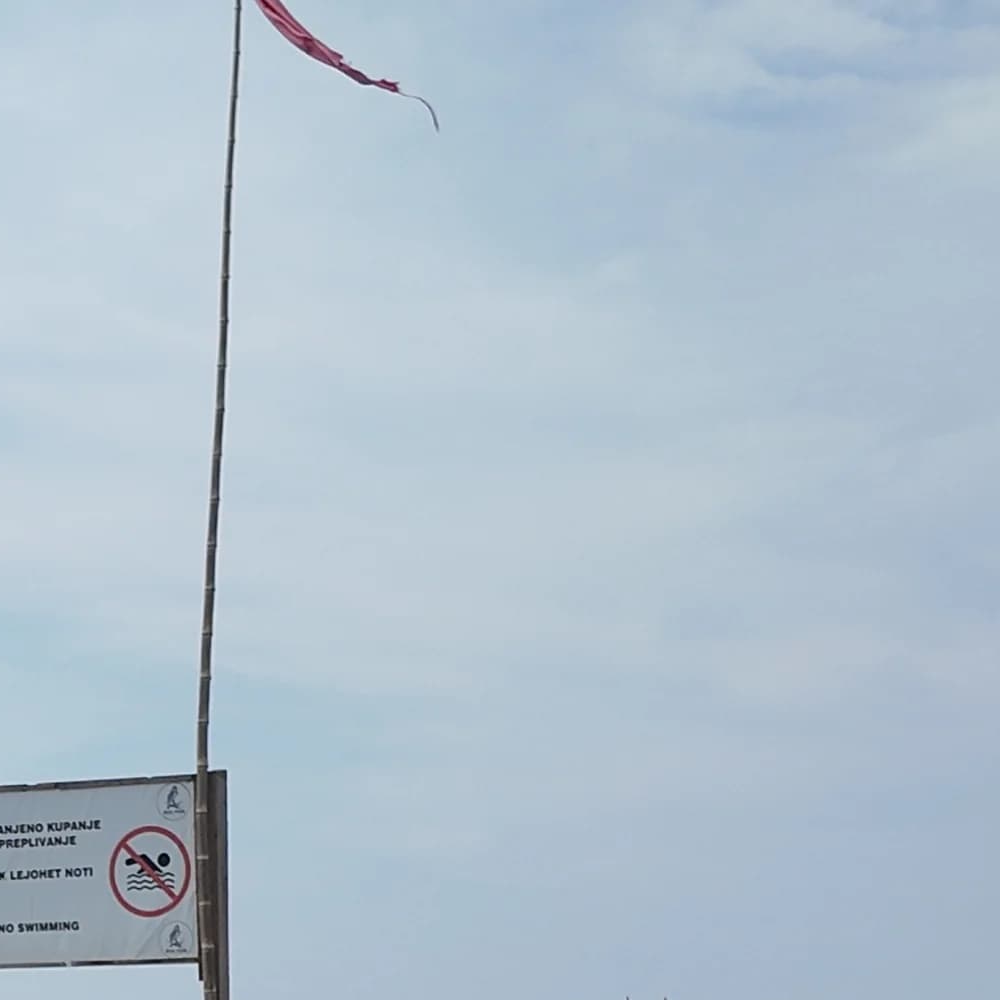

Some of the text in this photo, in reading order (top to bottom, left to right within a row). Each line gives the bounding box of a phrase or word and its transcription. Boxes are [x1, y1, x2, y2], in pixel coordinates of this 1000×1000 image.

[47, 819, 102, 832] KUPANJE
[10, 868, 62, 881] LEJOHET
[65, 866, 94, 878] NOTI
[18, 920, 80, 933] SWIMMING
